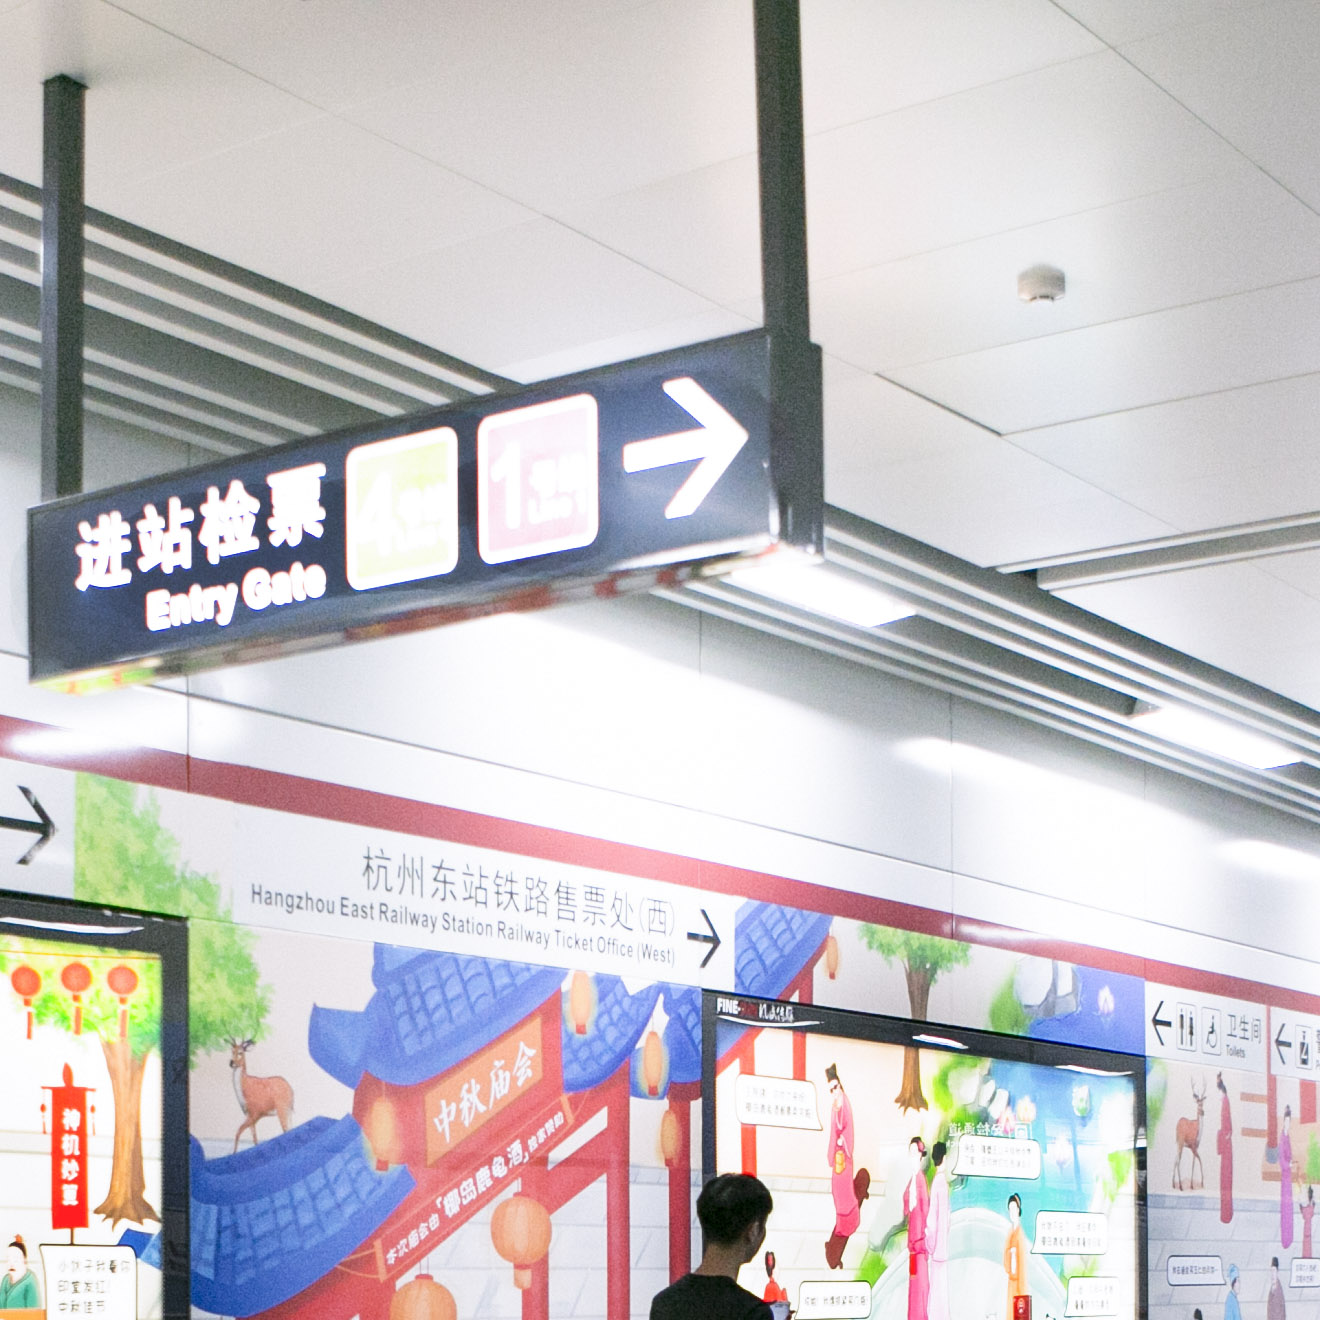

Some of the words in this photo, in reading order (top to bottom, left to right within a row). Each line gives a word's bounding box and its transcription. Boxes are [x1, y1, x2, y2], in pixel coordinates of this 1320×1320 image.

[75, 463, 328, 592] 进站检票
[146, 581, 239, 632] Entry
[242, 561, 328, 611] Gate
[251, 883, 336, 917] Hangzhou
[340, 896, 375, 922] East
[379, 901, 438, 934] Railway
[442, 911, 494, 938] Station
[497, 920, 551, 949] Railway
[555, 930, 593, 954] Ticket
[597, 936, 634, 959] Office
[636, 941, 675, 966] (West)
[1226, 1044, 1246, 1059] Toilets
[1227, 1014, 1262, 1045] 卫生间
[433, 1041, 537, 1143] 中秋庙会
